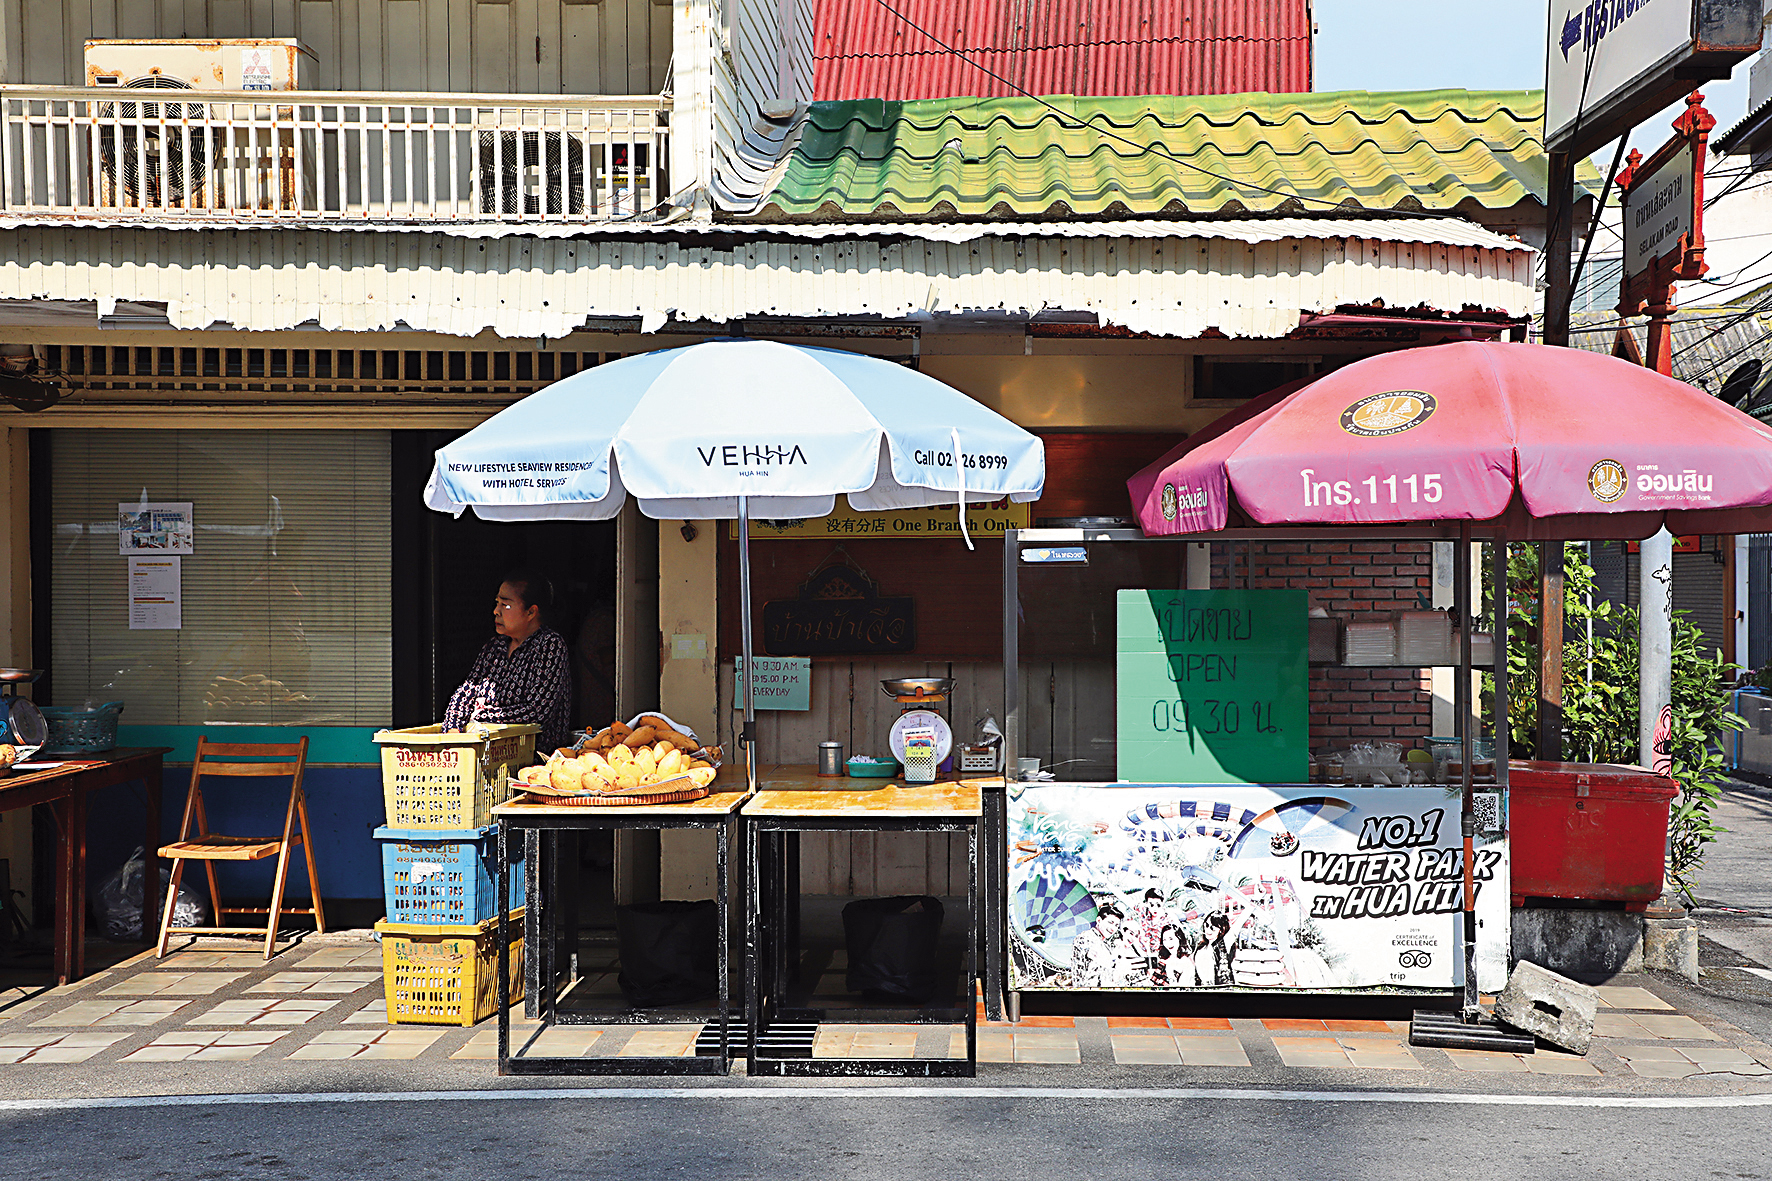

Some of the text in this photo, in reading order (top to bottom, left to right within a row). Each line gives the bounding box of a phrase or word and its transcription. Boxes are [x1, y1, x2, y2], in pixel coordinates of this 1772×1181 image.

[1639, 216, 1678, 256] SELAKAM ROAD
[449, 464, 472, 472] NEW
[474, 463, 516, 473] LIFESTYLE
[517, 463, 552, 472] SEAVIEW
[914, 450, 1008, 470] Call 02 26 8999
[483, 479, 507, 488] WITH
[508, 479, 534, 488] HOTEL
[1636, 469, 1713, 492] ออมสิน
[1676, 494, 1698, 502] Savings
[826, 518, 886, 533] 没有分店
[893, 518, 1018, 532] One Branh Only
[1158, 598, 1251, 642] เปิดขาย
[738, 661, 759, 670] ON
[1167, 653, 1236, 682] OPEN
[395, 745, 459, 762] จันทร์เจ้า
[1357, 808, 1445, 850] NO.1
[1302, 851, 1409, 885] WATER
[1310, 895, 1344, 919] IN
[1342, 882, 1410, 919] HUA
[1390, 972, 1406, 981] trip
